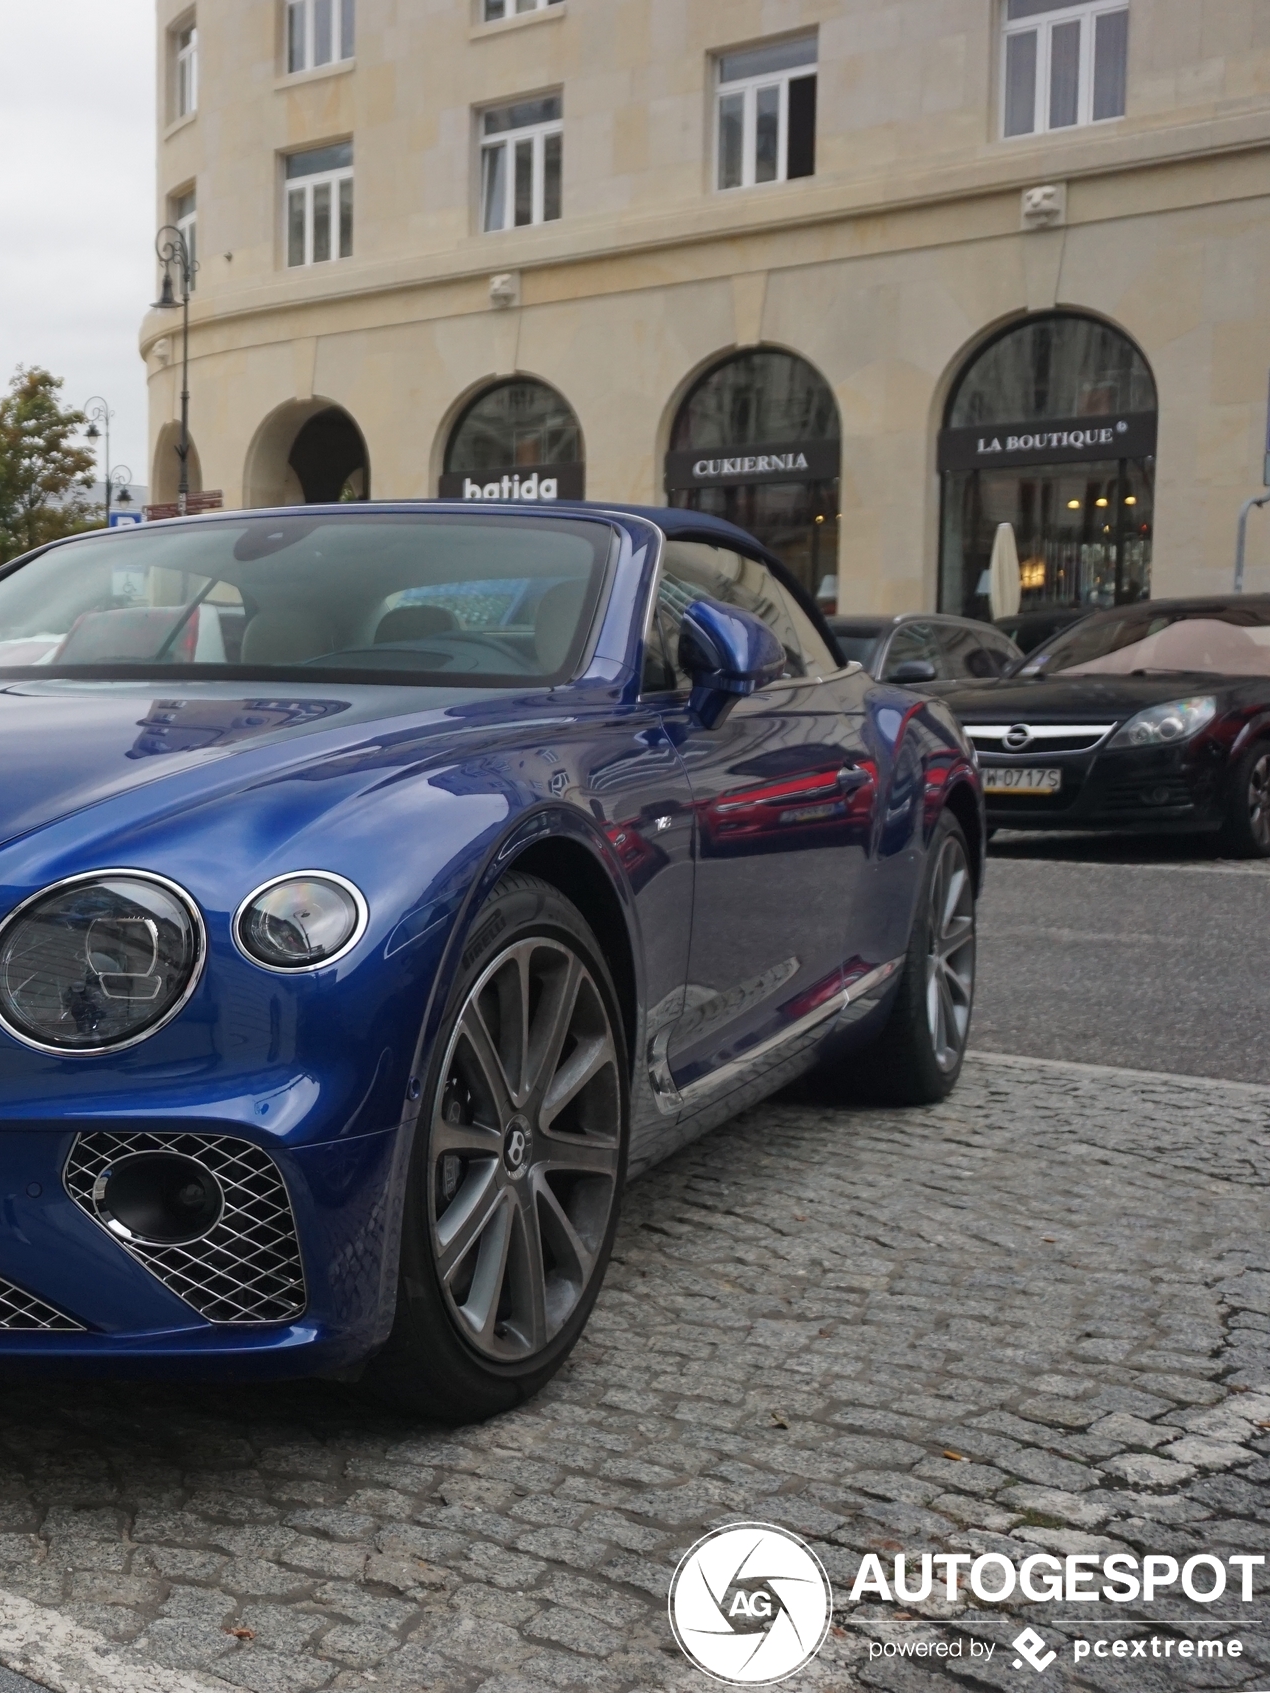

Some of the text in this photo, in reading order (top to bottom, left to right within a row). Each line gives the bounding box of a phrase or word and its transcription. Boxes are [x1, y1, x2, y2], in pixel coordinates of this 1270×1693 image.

[977, 428, 1114, 452] LA BOUTIQUE
[693, 452, 809, 477] CUKIERNIA
[464, 473, 558, 499] batida
[1004, 770, 1059, 787] 0717S
